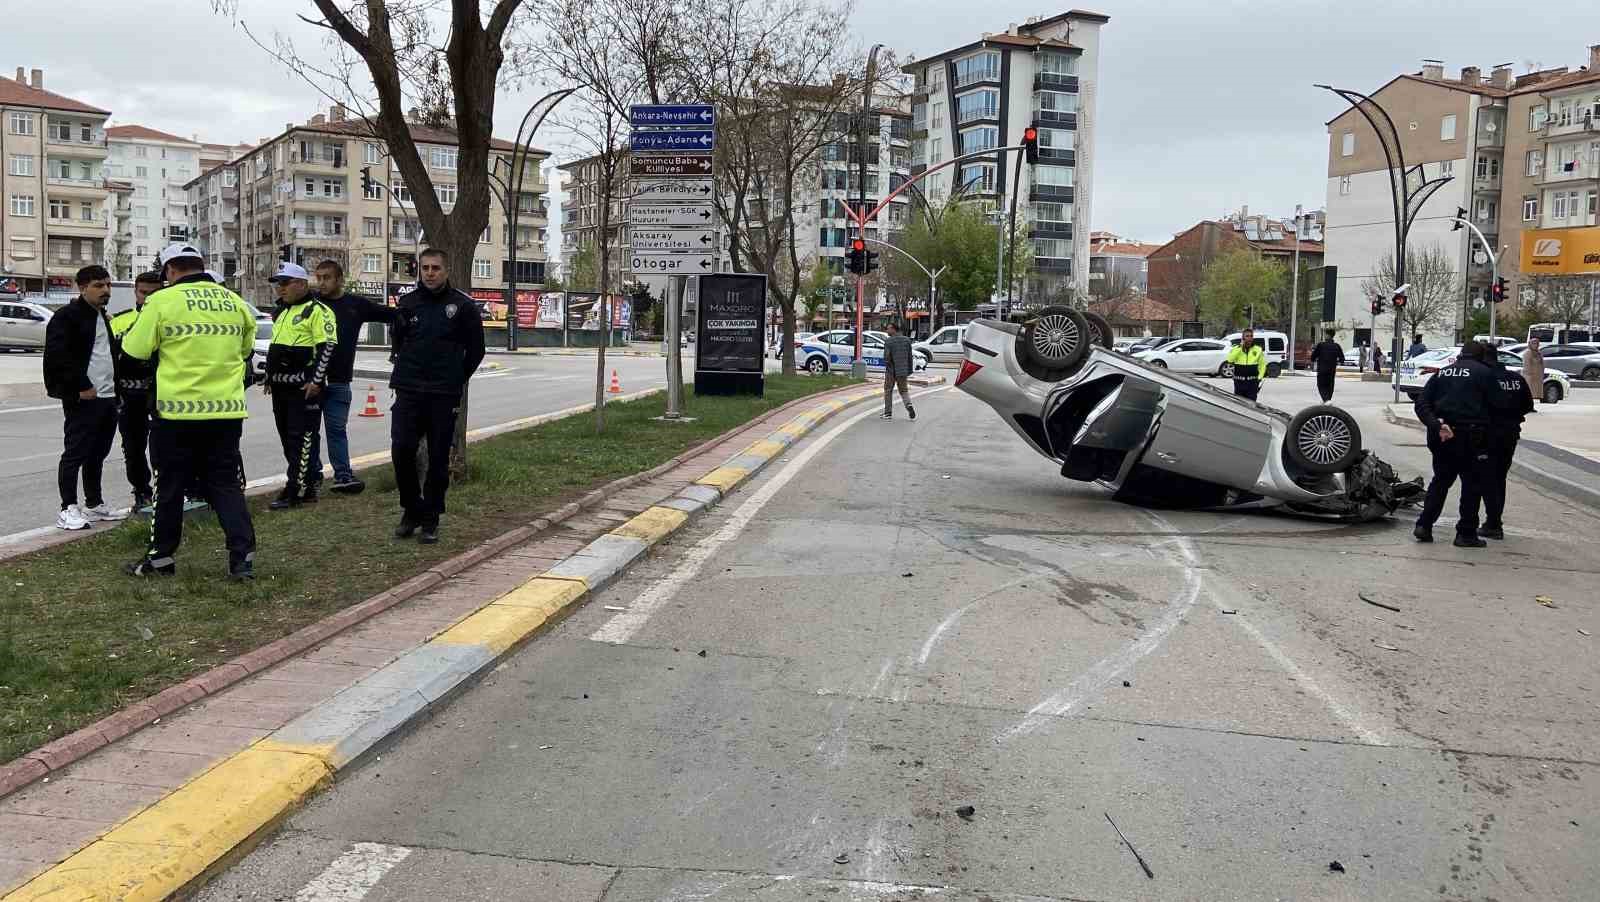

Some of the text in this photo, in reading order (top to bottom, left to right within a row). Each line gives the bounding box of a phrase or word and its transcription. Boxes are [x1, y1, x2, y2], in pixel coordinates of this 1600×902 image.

[632, 157, 698, 165] Somuncu Baba
[633, 232, 672, 240] Aksaray
[633, 257, 683, 270] Otogar
[186, 300, 238, 312] POLİSİ
[1438, 368, 1470, 377] POLİS
